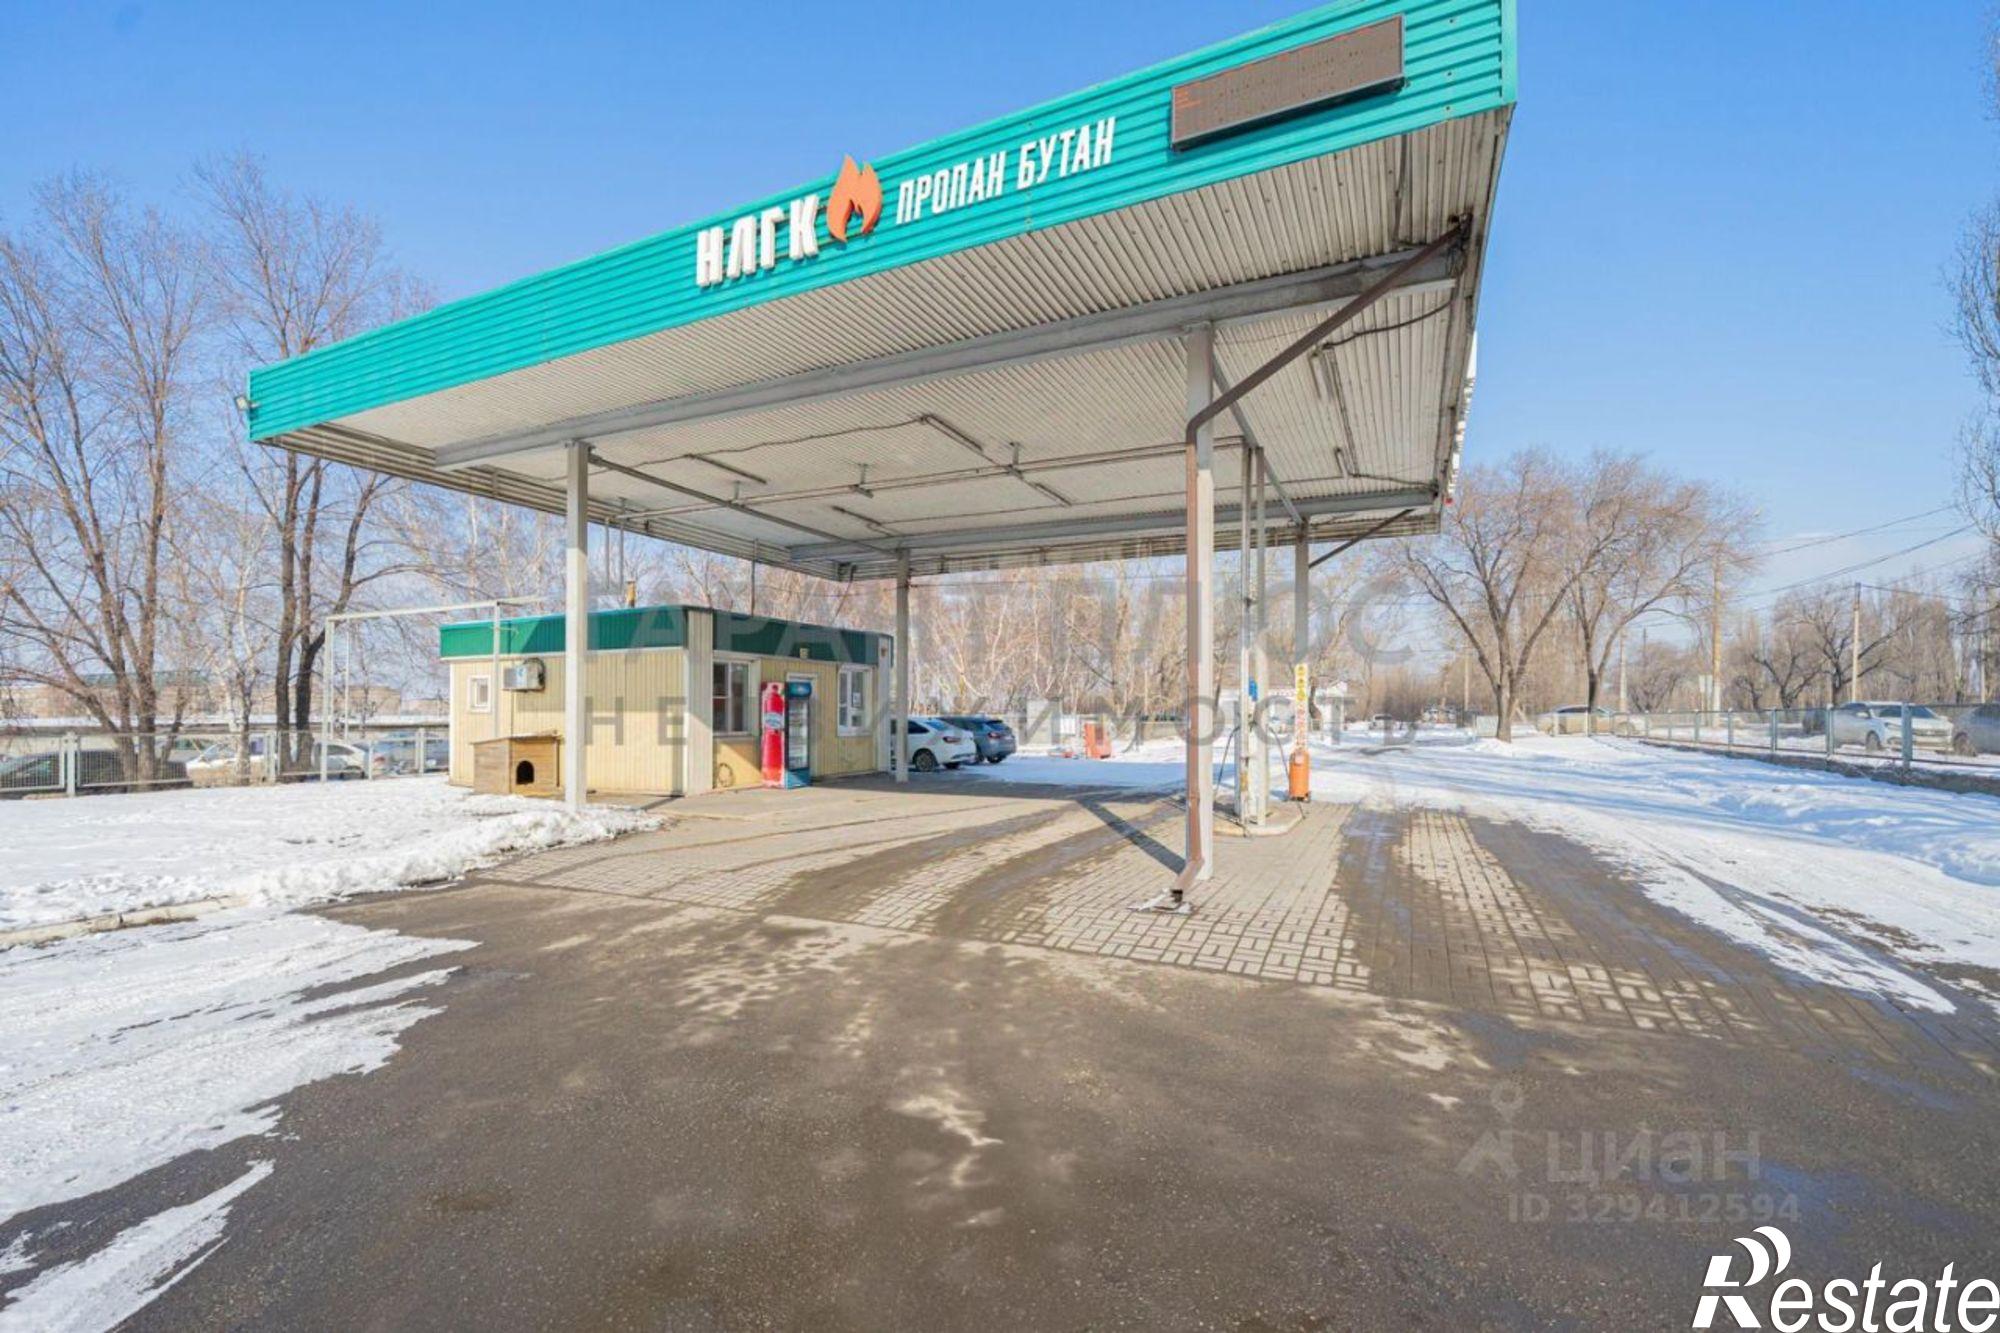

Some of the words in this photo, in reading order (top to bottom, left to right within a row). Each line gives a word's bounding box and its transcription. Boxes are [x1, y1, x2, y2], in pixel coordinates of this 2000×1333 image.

[896, 150, 1006, 225] ПРОПАН
[1017, 116, 1116, 190] БУТАН
[696, 194, 819, 287] НЛГК
